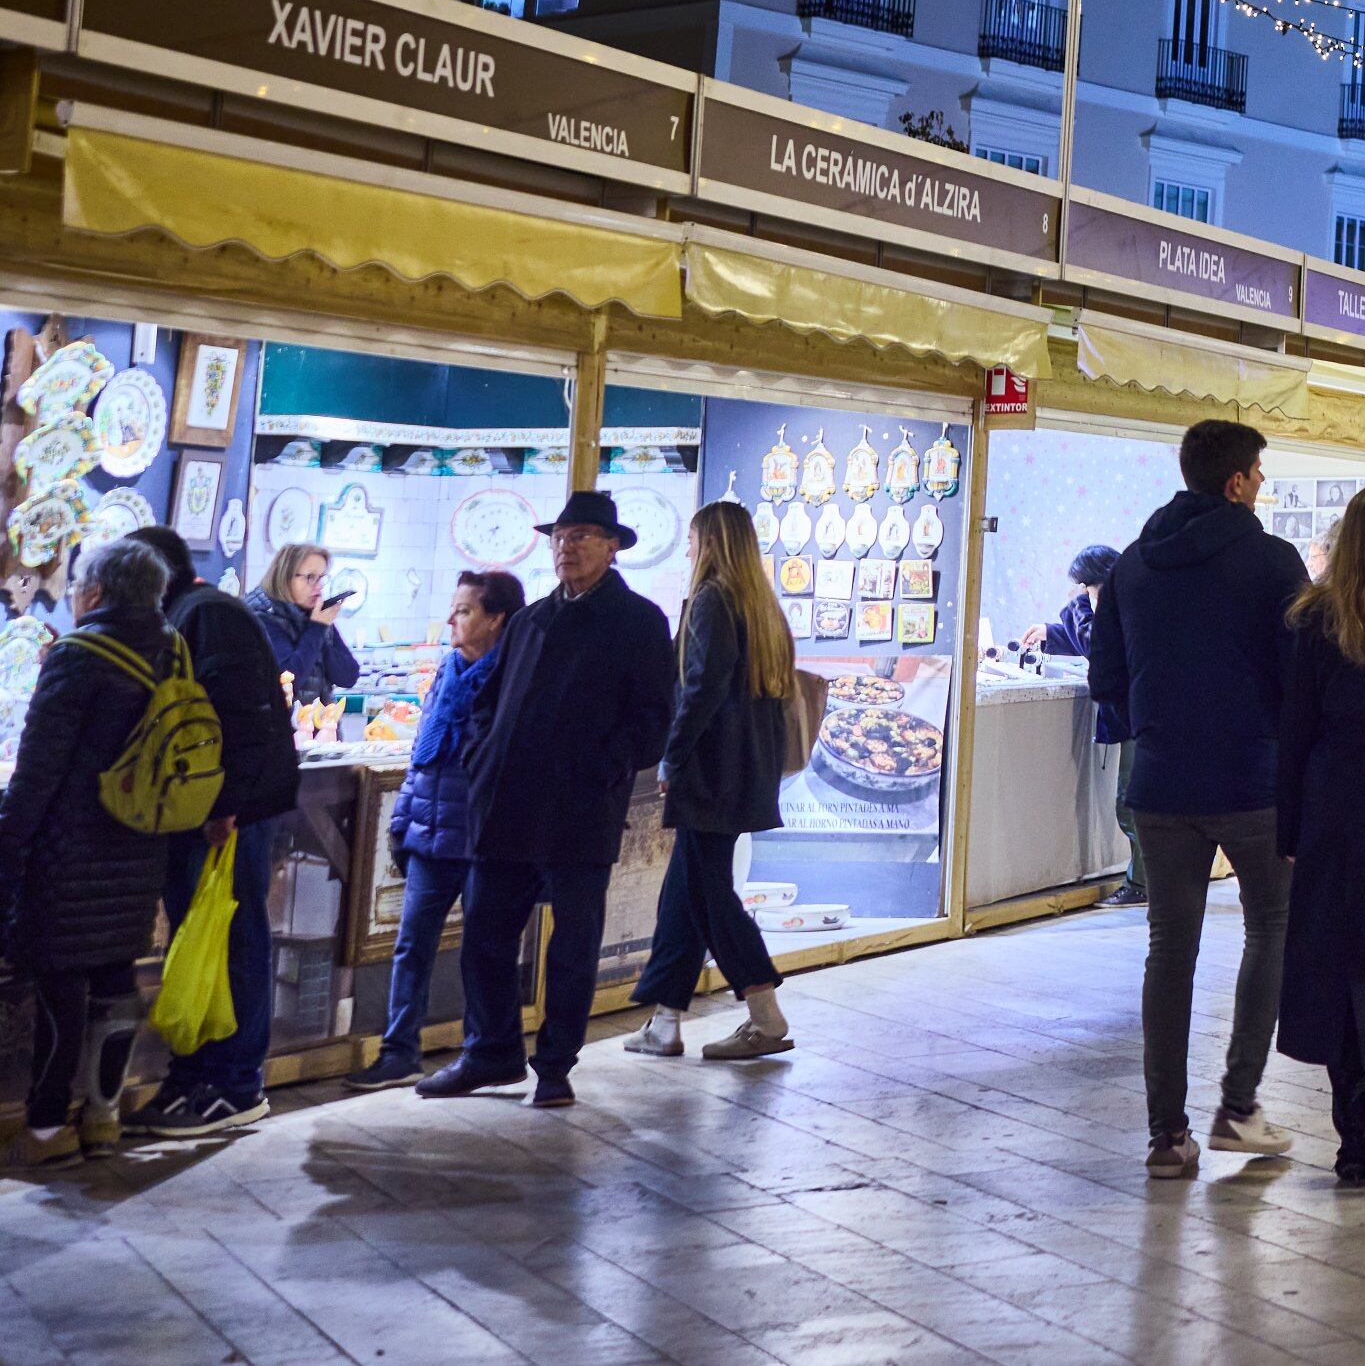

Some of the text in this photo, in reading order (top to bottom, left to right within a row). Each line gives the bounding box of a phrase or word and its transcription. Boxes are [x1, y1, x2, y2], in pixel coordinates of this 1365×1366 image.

[394, 31, 496, 98] CLAUR
[547, 112, 629, 157] VALENCIA
[669, 115, 679, 141] 7
[770, 134, 797, 176] LA
[801, 144, 901, 204] CERÁMICA
[1042, 213, 1049, 234] 8
[1159, 240, 1226, 284] PLATA IDEA
[1235, 283, 1272, 309] VALENCIA
[1288, 286, 1294, 303] 9
[985, 402, 1028, 413] EXTINTOR
[840, 802, 878, 813] PINTADES
[839, 818, 877, 829] PINTADAS
[886, 819, 910, 829] MANO
